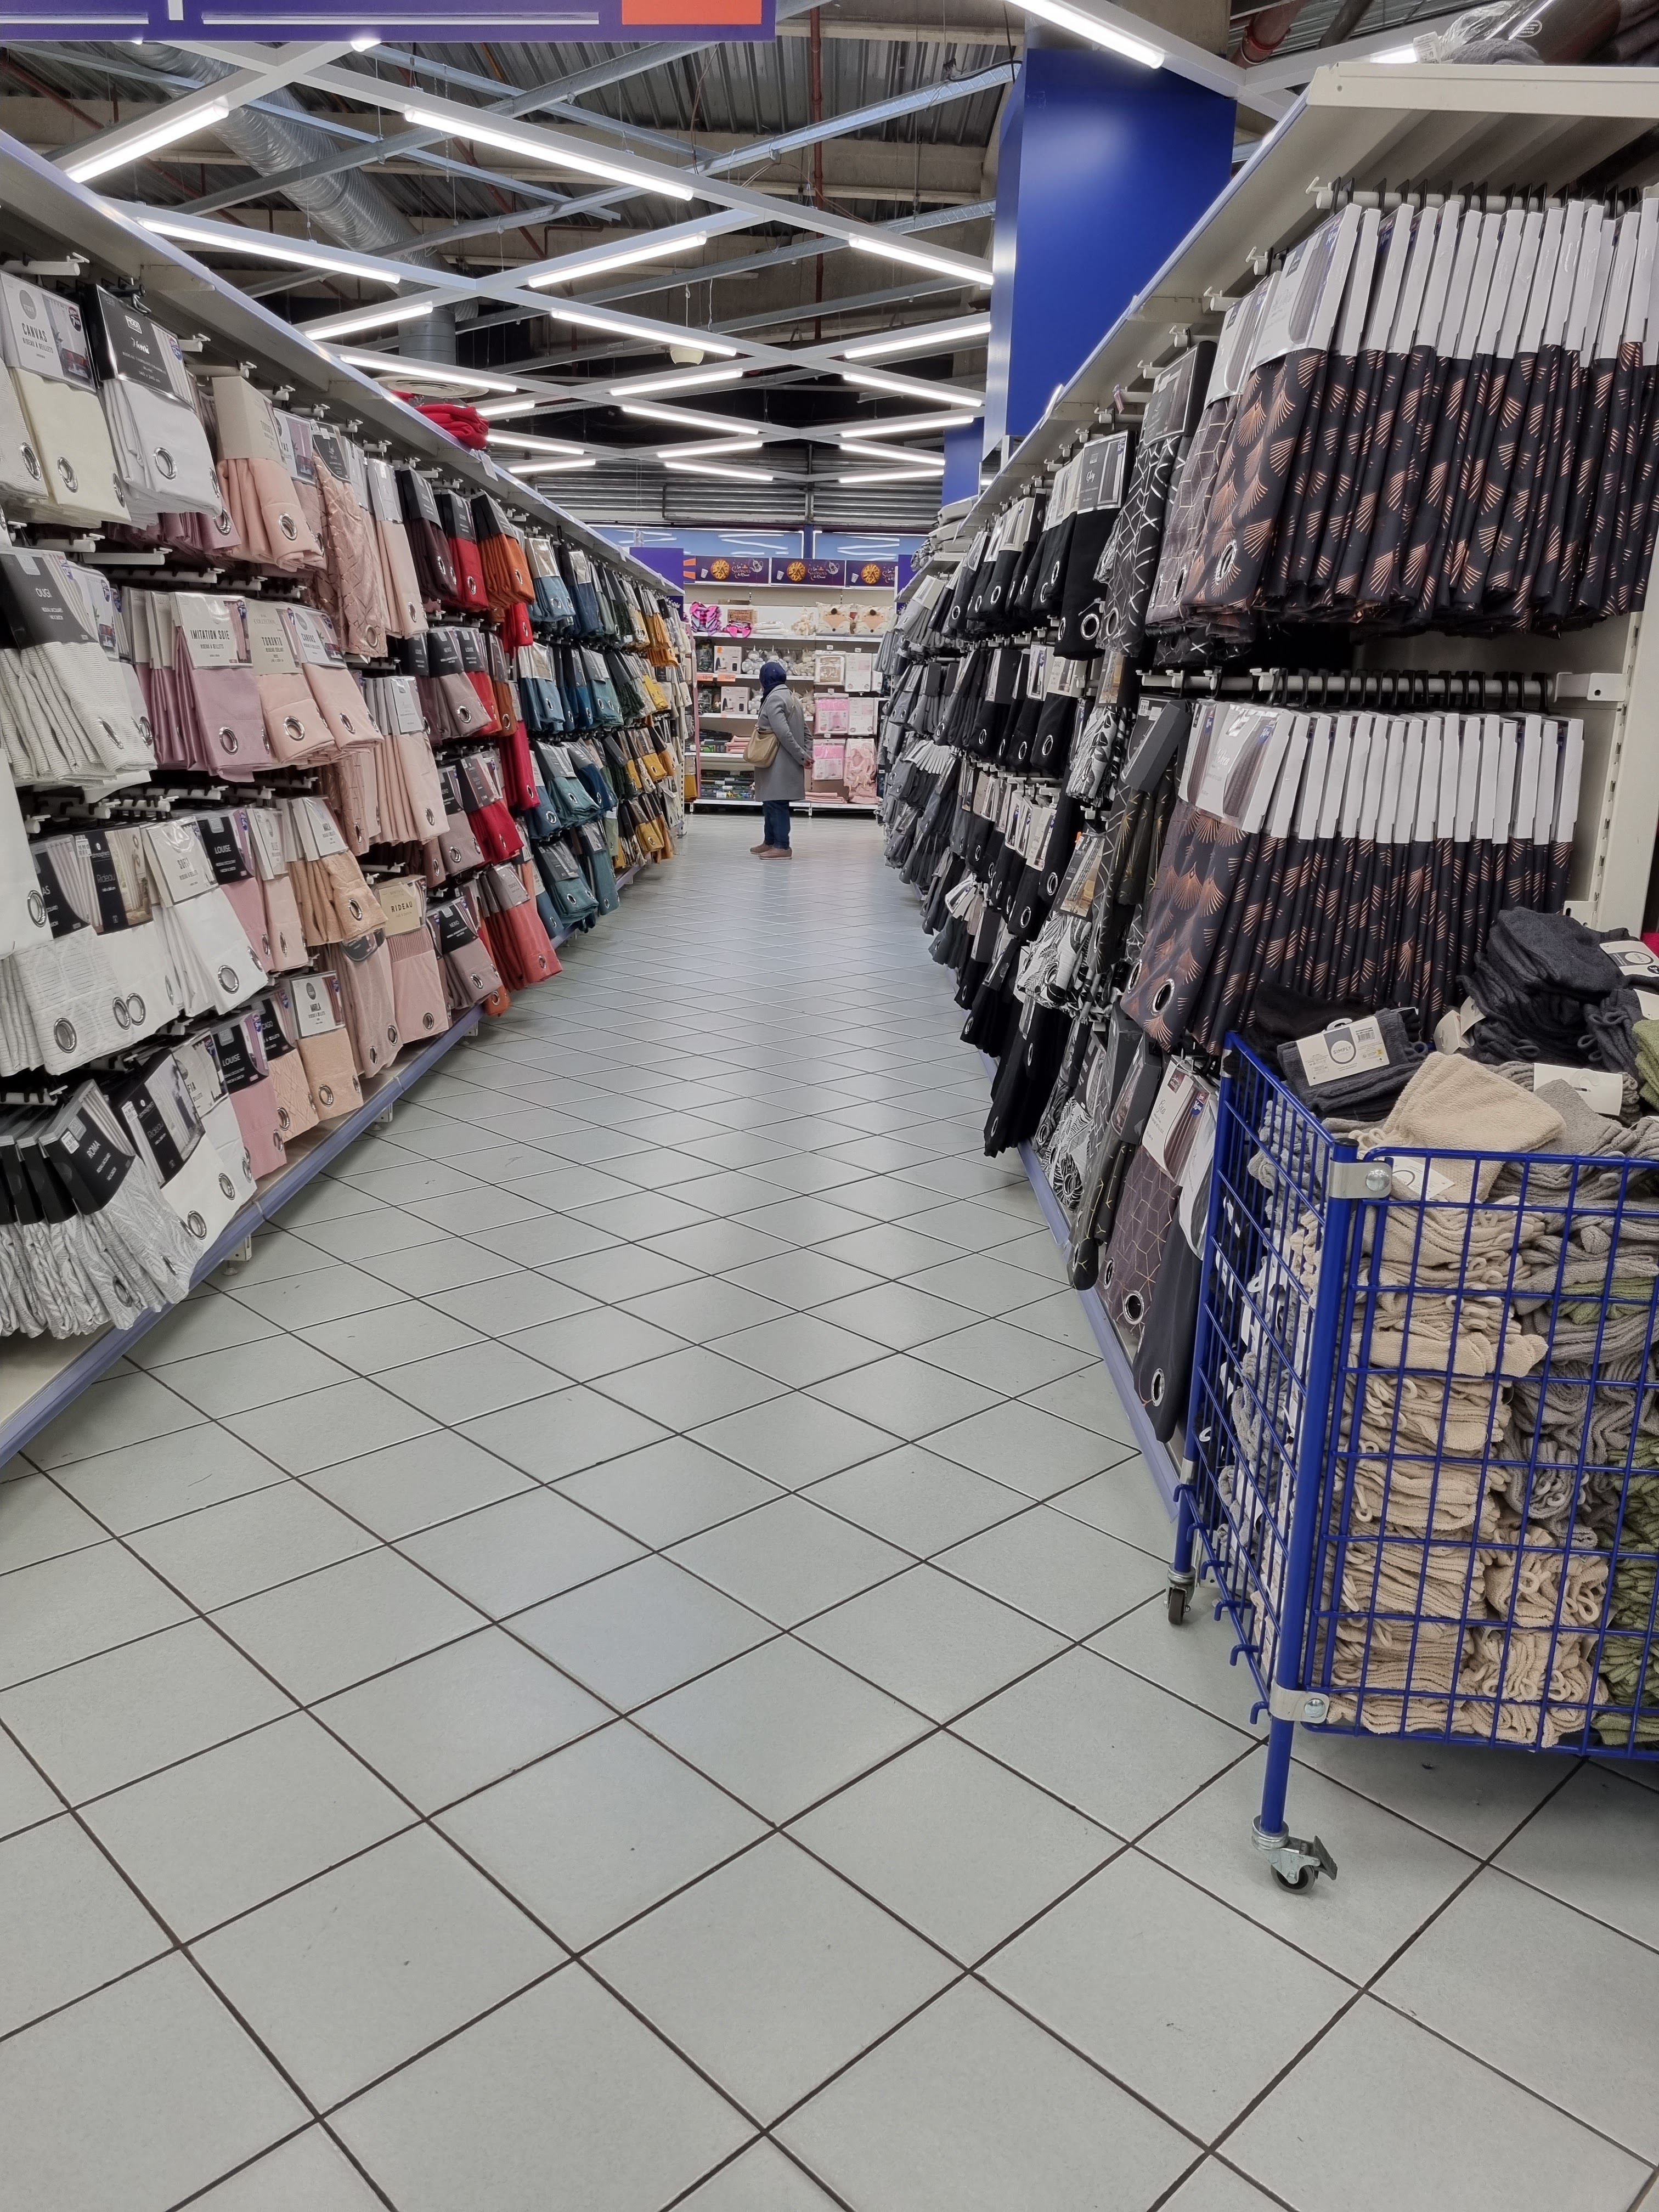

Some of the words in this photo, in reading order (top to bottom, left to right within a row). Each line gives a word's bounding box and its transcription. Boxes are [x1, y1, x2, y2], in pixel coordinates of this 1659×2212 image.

[22, 323, 48, 343] CANVAS
[190, 629, 217, 640] IMITATION
[218, 630, 230, 640] SOIE
[261, 636, 283, 646] TORONTO
[215, 844, 232, 854] LOUISE
[96, 874, 116, 884] Rideau
[391, 901, 413, 913] RIDEAU
[1333, 1046, 1352, 1055] SIMPLY
[222, 1053, 241, 1066] LOUISE
[86, 1140, 101, 1159] ROMA
